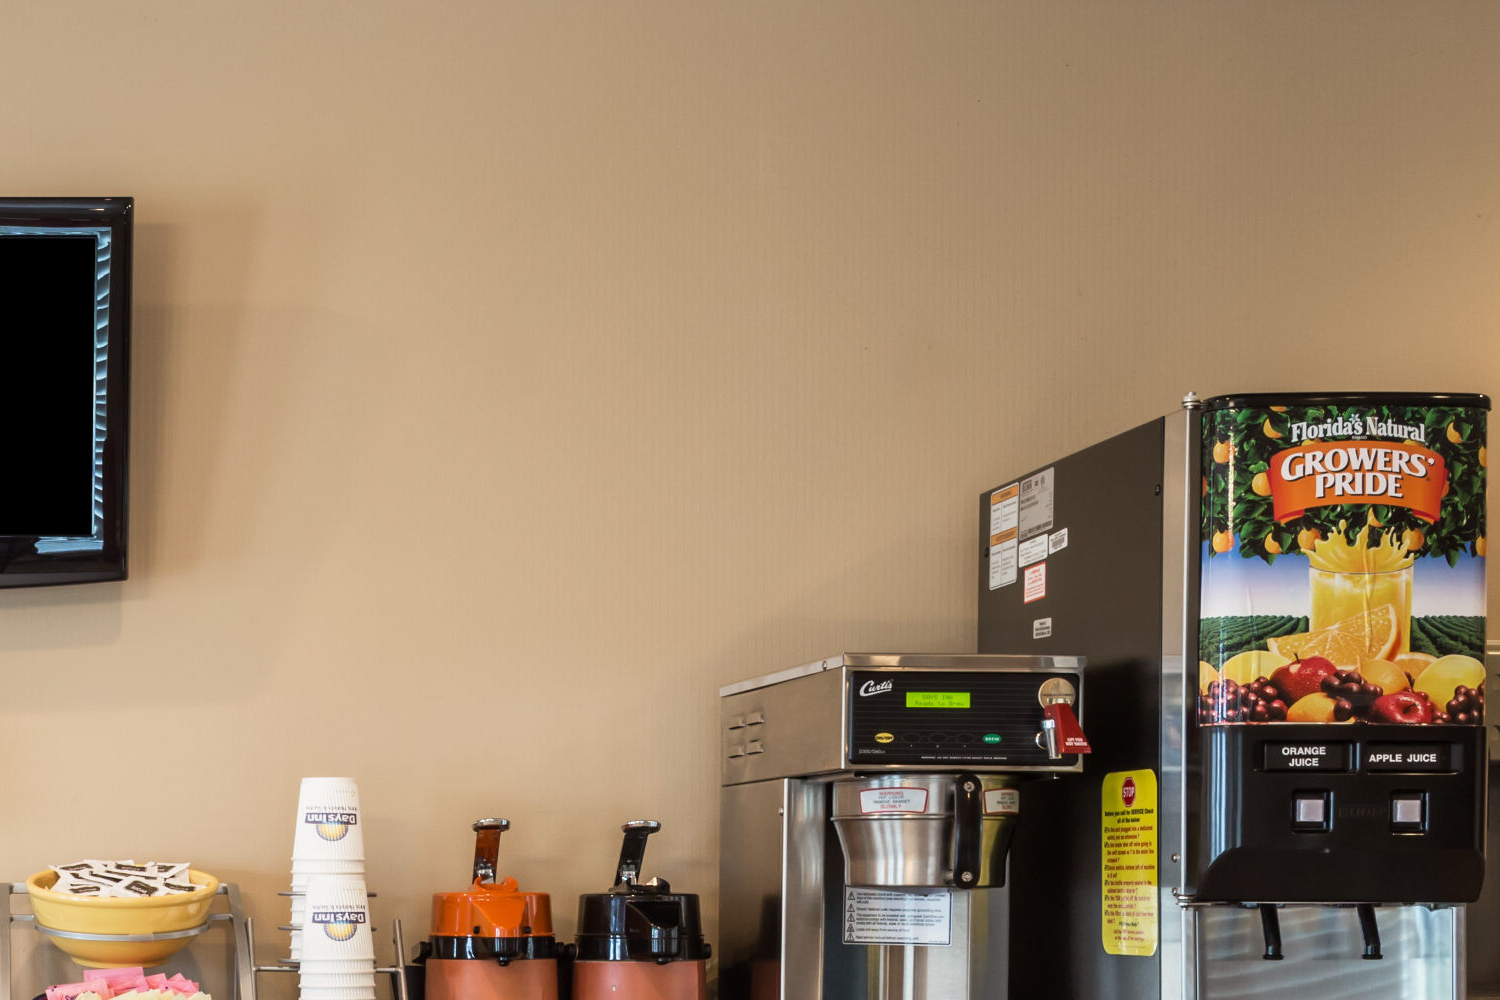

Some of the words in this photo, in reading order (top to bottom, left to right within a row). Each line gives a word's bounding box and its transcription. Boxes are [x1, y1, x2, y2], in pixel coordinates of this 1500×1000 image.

[1291, 416, 1363, 442] Florida's
[1366, 416, 1426, 442] Natural
[1281, 448, 1435, 481] GROWERS'
[1315, 472, 1404, 498] PRIDE
[860, 679, 893, 697] Curtis
[1281, 746, 1327, 756] ORANGE
[1288, 758, 1319, 767] JUICE
[1369, 754, 1403, 763] APPLE
[1406, 754, 1437, 763] JUICE
[1123, 786, 1135, 798] STOP
[307, 813, 327, 823] Inn
[328, 813, 356, 824] Days
[314, 912, 334, 922] Inn
[335, 912, 365, 922] Days
